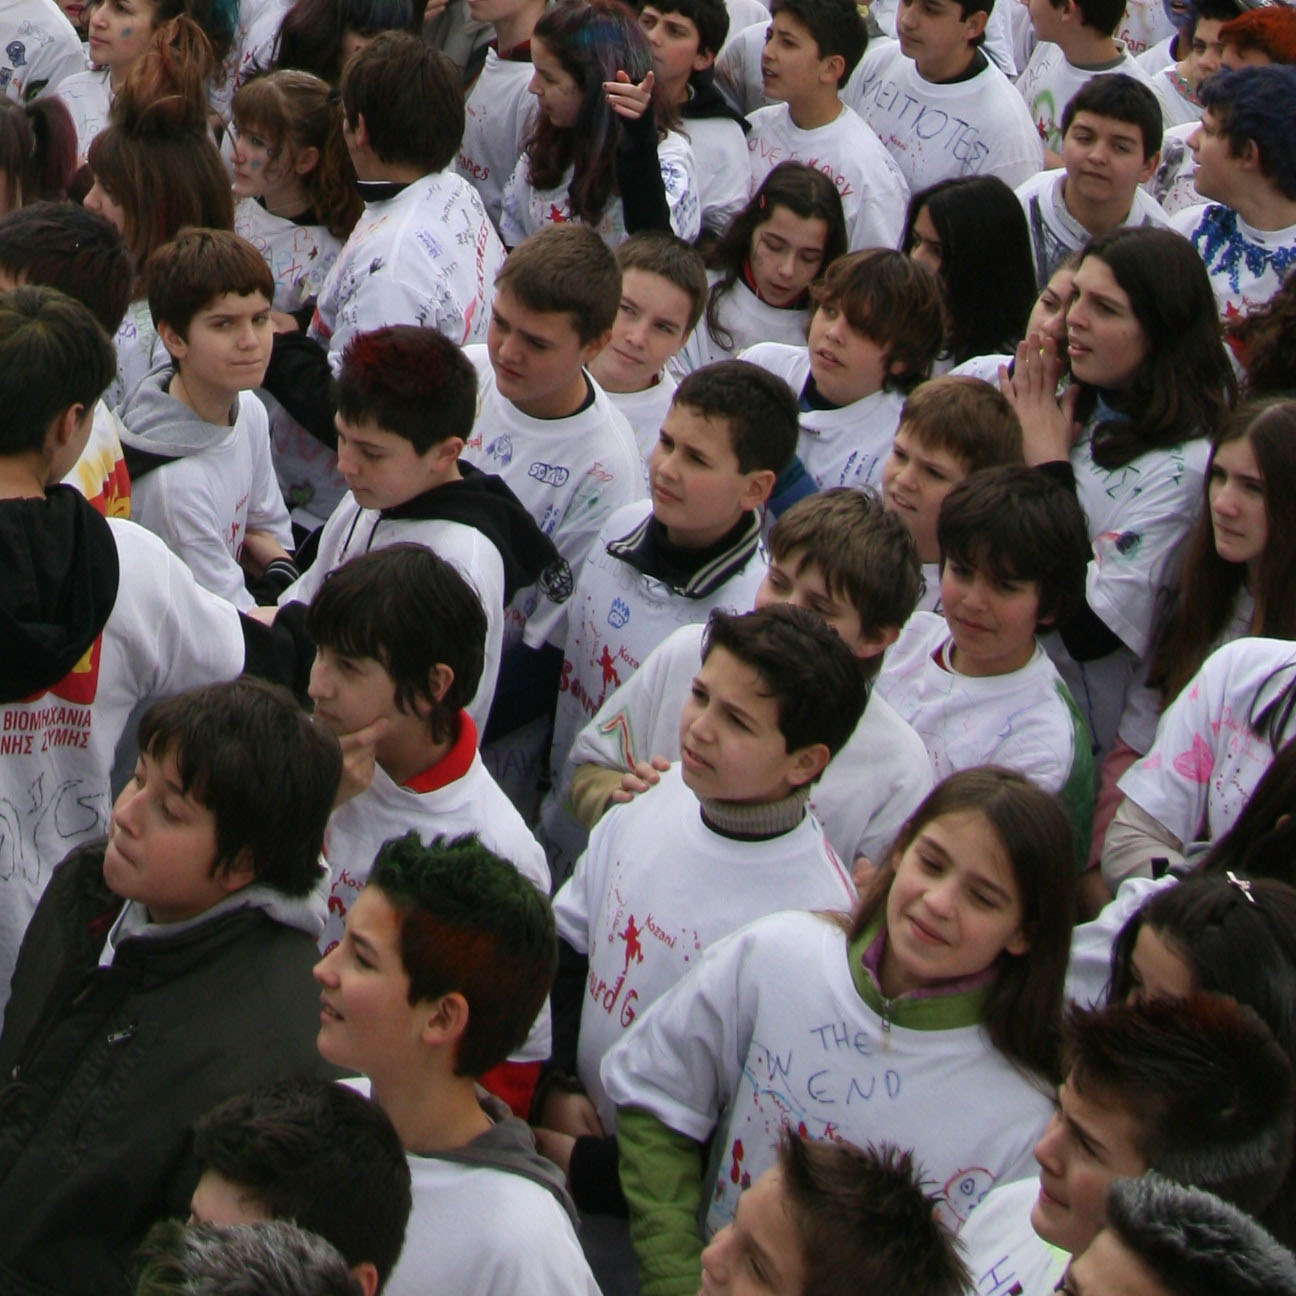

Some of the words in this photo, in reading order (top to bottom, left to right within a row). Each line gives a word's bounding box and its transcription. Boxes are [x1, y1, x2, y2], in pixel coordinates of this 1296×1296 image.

[617, 644, 641, 670] Koza
[3, 708, 92, 732] ΒΙΟΜΗΧΑΝΙΑ
[643, 912, 678, 949] Kozani
[589, 966, 625, 1015] urd
[809, 1021, 873, 1057] THE
[807, 1069, 902, 1105] END
